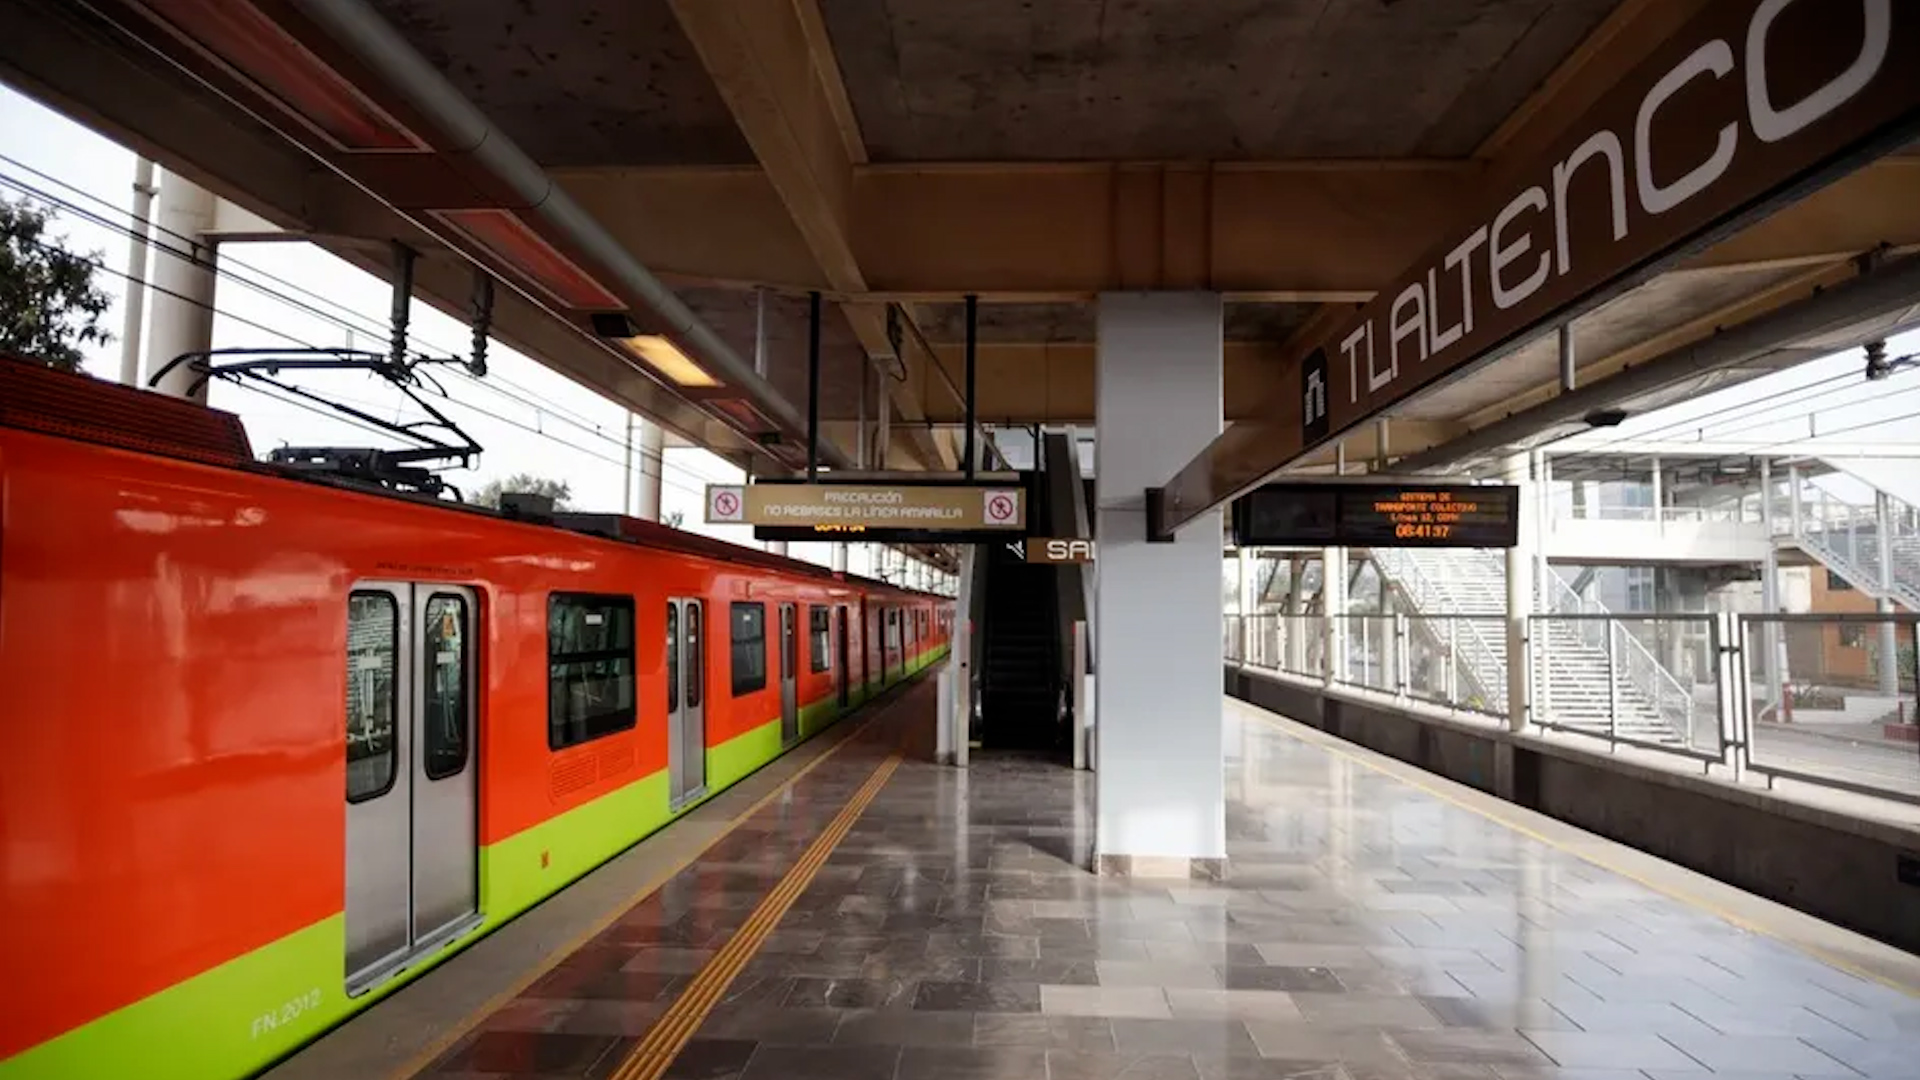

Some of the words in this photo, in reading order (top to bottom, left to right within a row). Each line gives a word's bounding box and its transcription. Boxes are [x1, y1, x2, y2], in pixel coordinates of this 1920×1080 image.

[1340, 0, 1891, 404] TLALTENCO
[764, 504, 781, 517] NO
[784, 505, 841, 517] REBASES
[844, 506, 860, 517] LA
[901, 507, 963, 519] AMARILLA
